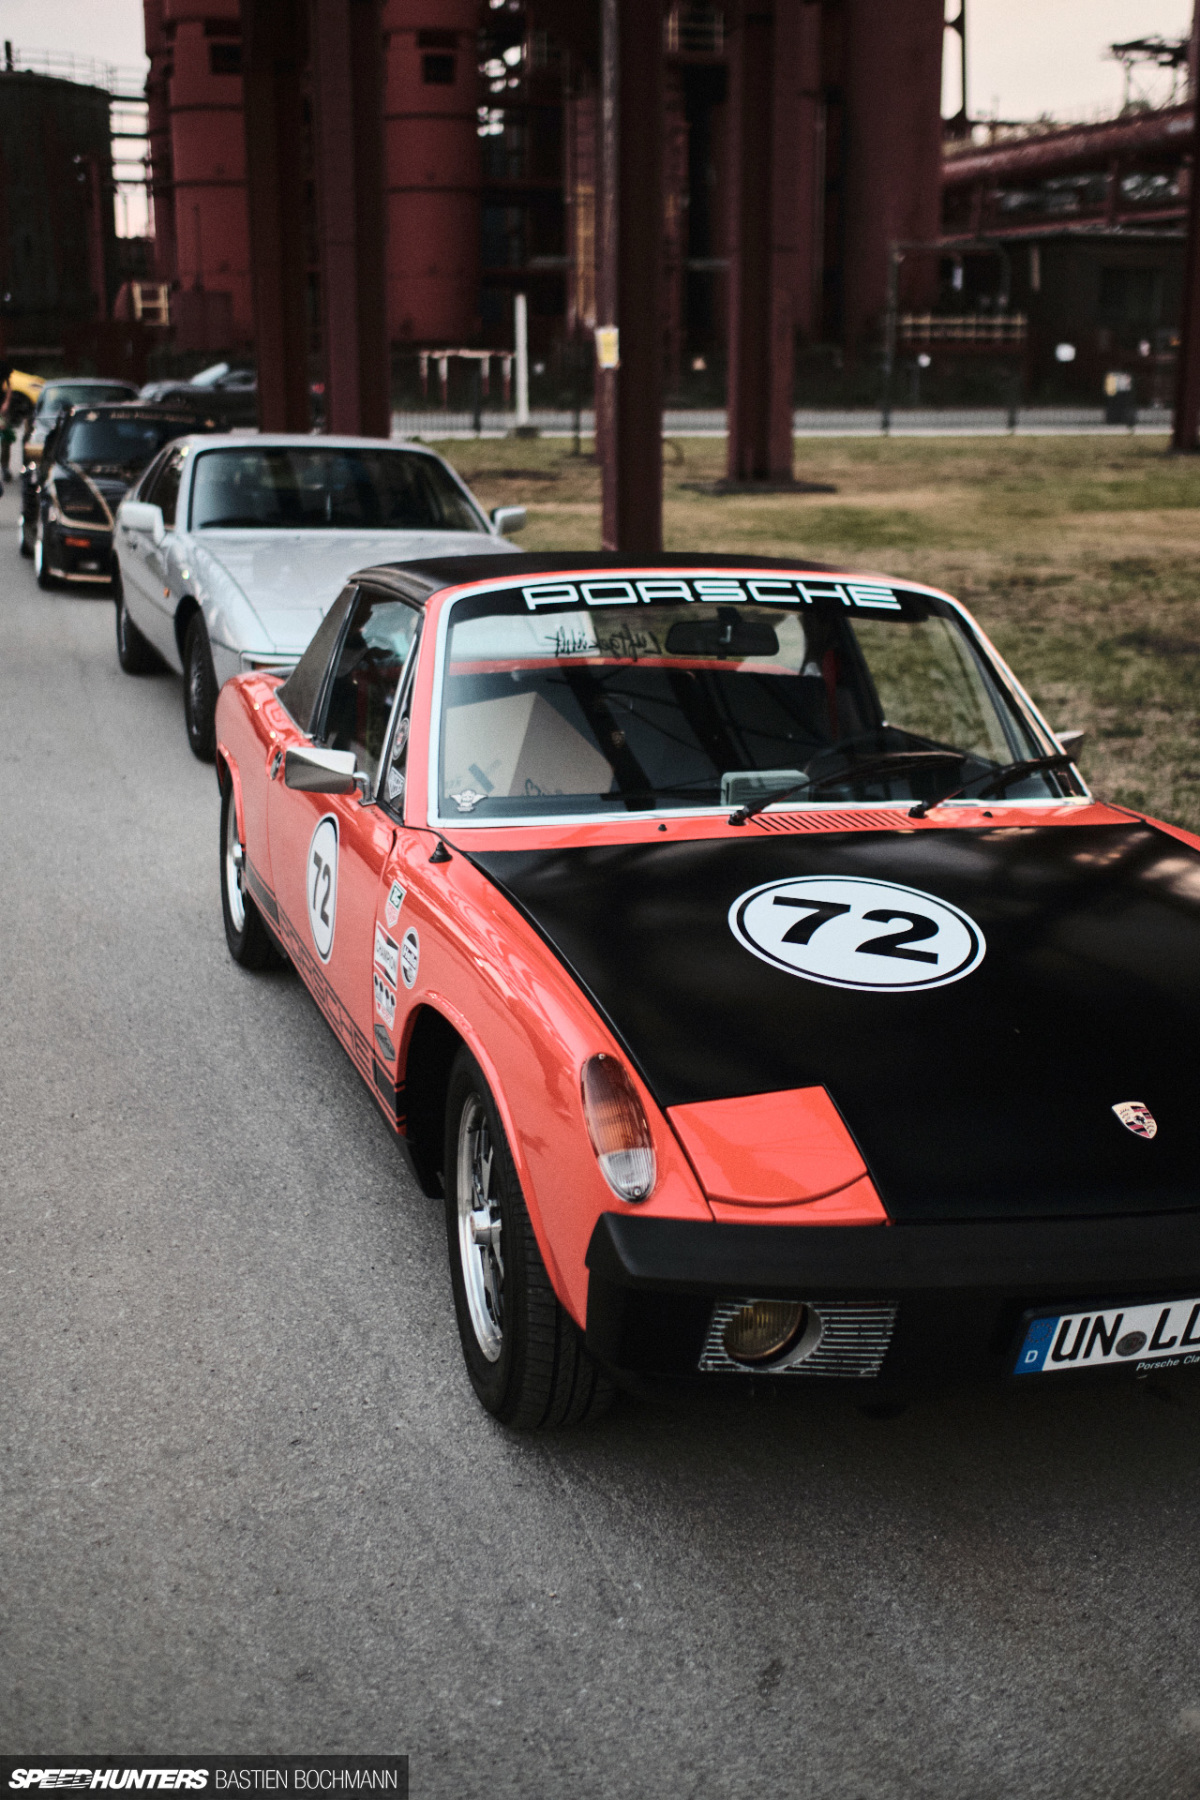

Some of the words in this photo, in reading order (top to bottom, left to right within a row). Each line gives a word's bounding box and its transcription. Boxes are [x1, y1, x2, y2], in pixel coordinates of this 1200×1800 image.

[522, 580, 901, 610] PORSCHE
[313, 850, 331, 929] 72
[772, 895, 940, 965] 72
[1024, 1350, 1038, 1363] D
[1051, 1313, 1124, 1362] UN
[1136, 1357, 1180, 1372] Porsche
